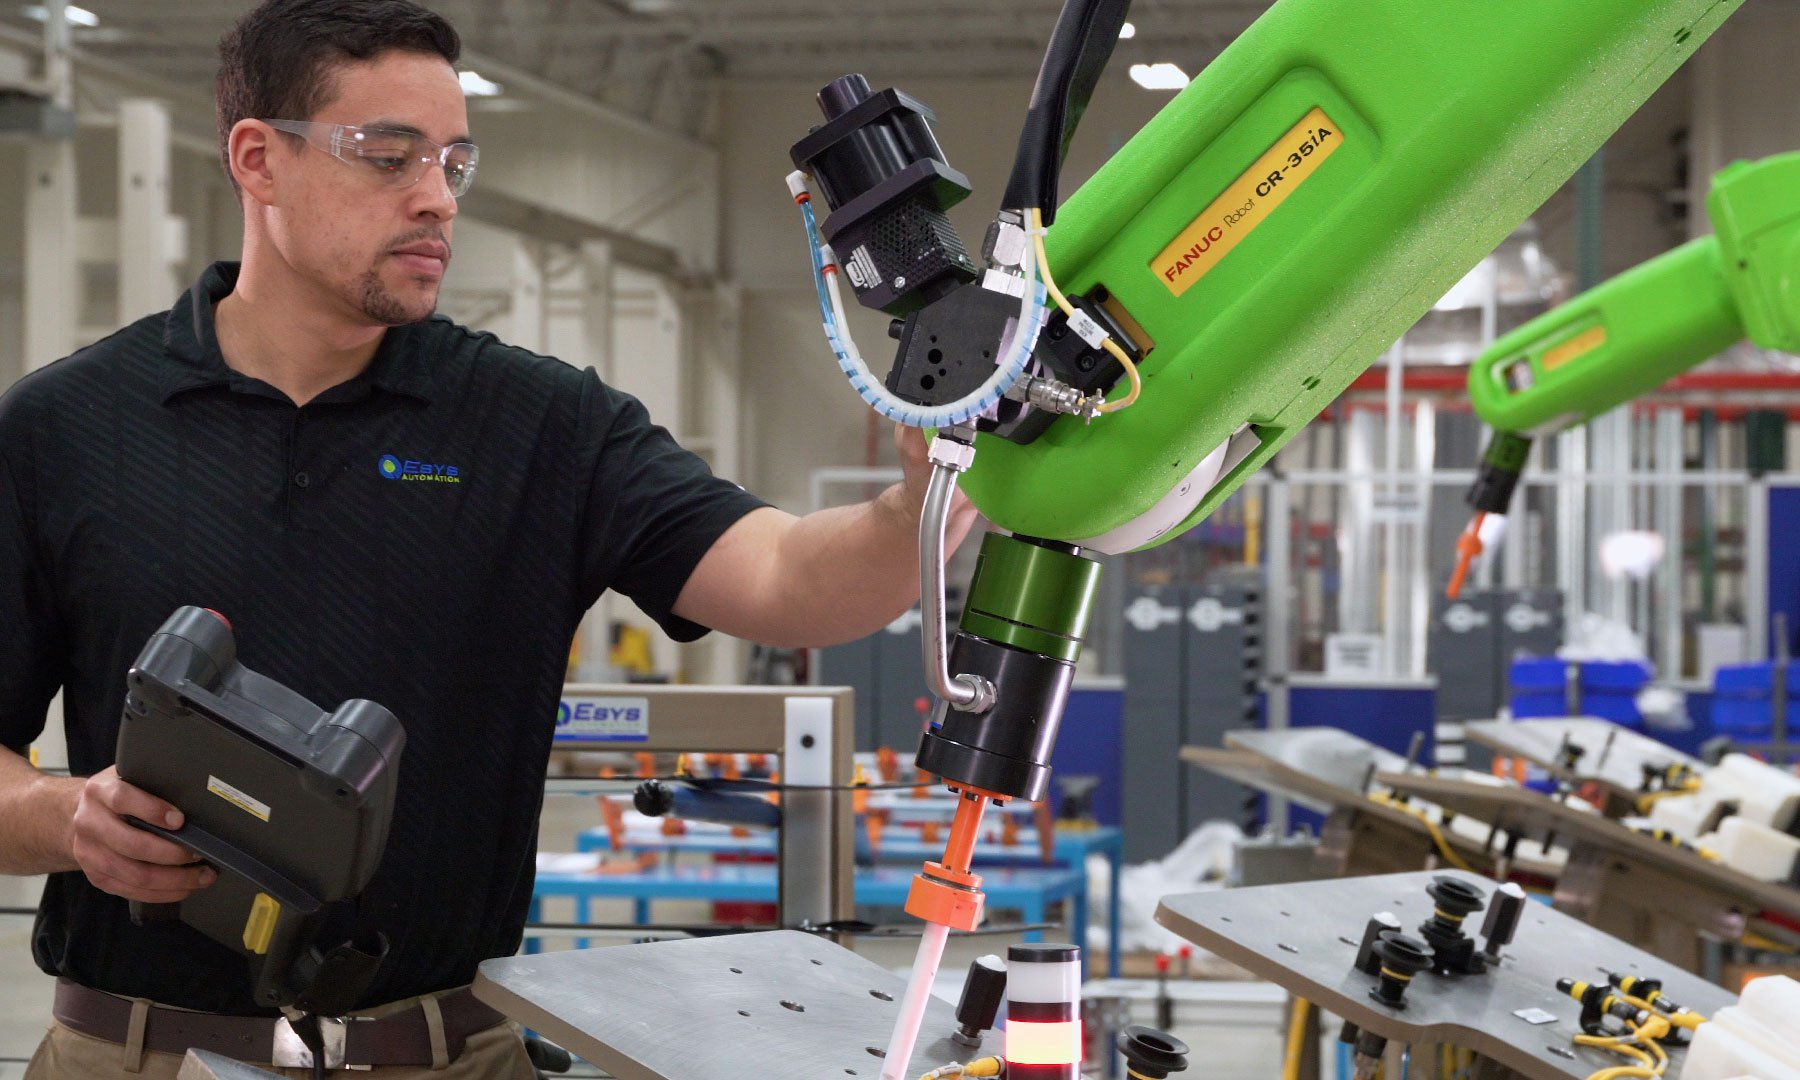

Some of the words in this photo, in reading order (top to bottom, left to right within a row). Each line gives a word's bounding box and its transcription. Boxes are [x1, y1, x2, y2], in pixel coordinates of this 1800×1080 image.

[1165, 226, 1223, 282] FANUC
[1223, 198, 1255, 228] Robot
[1255, 127, 1332, 197] CR-35iA
[402, 474, 460, 482] AUTOMATION
